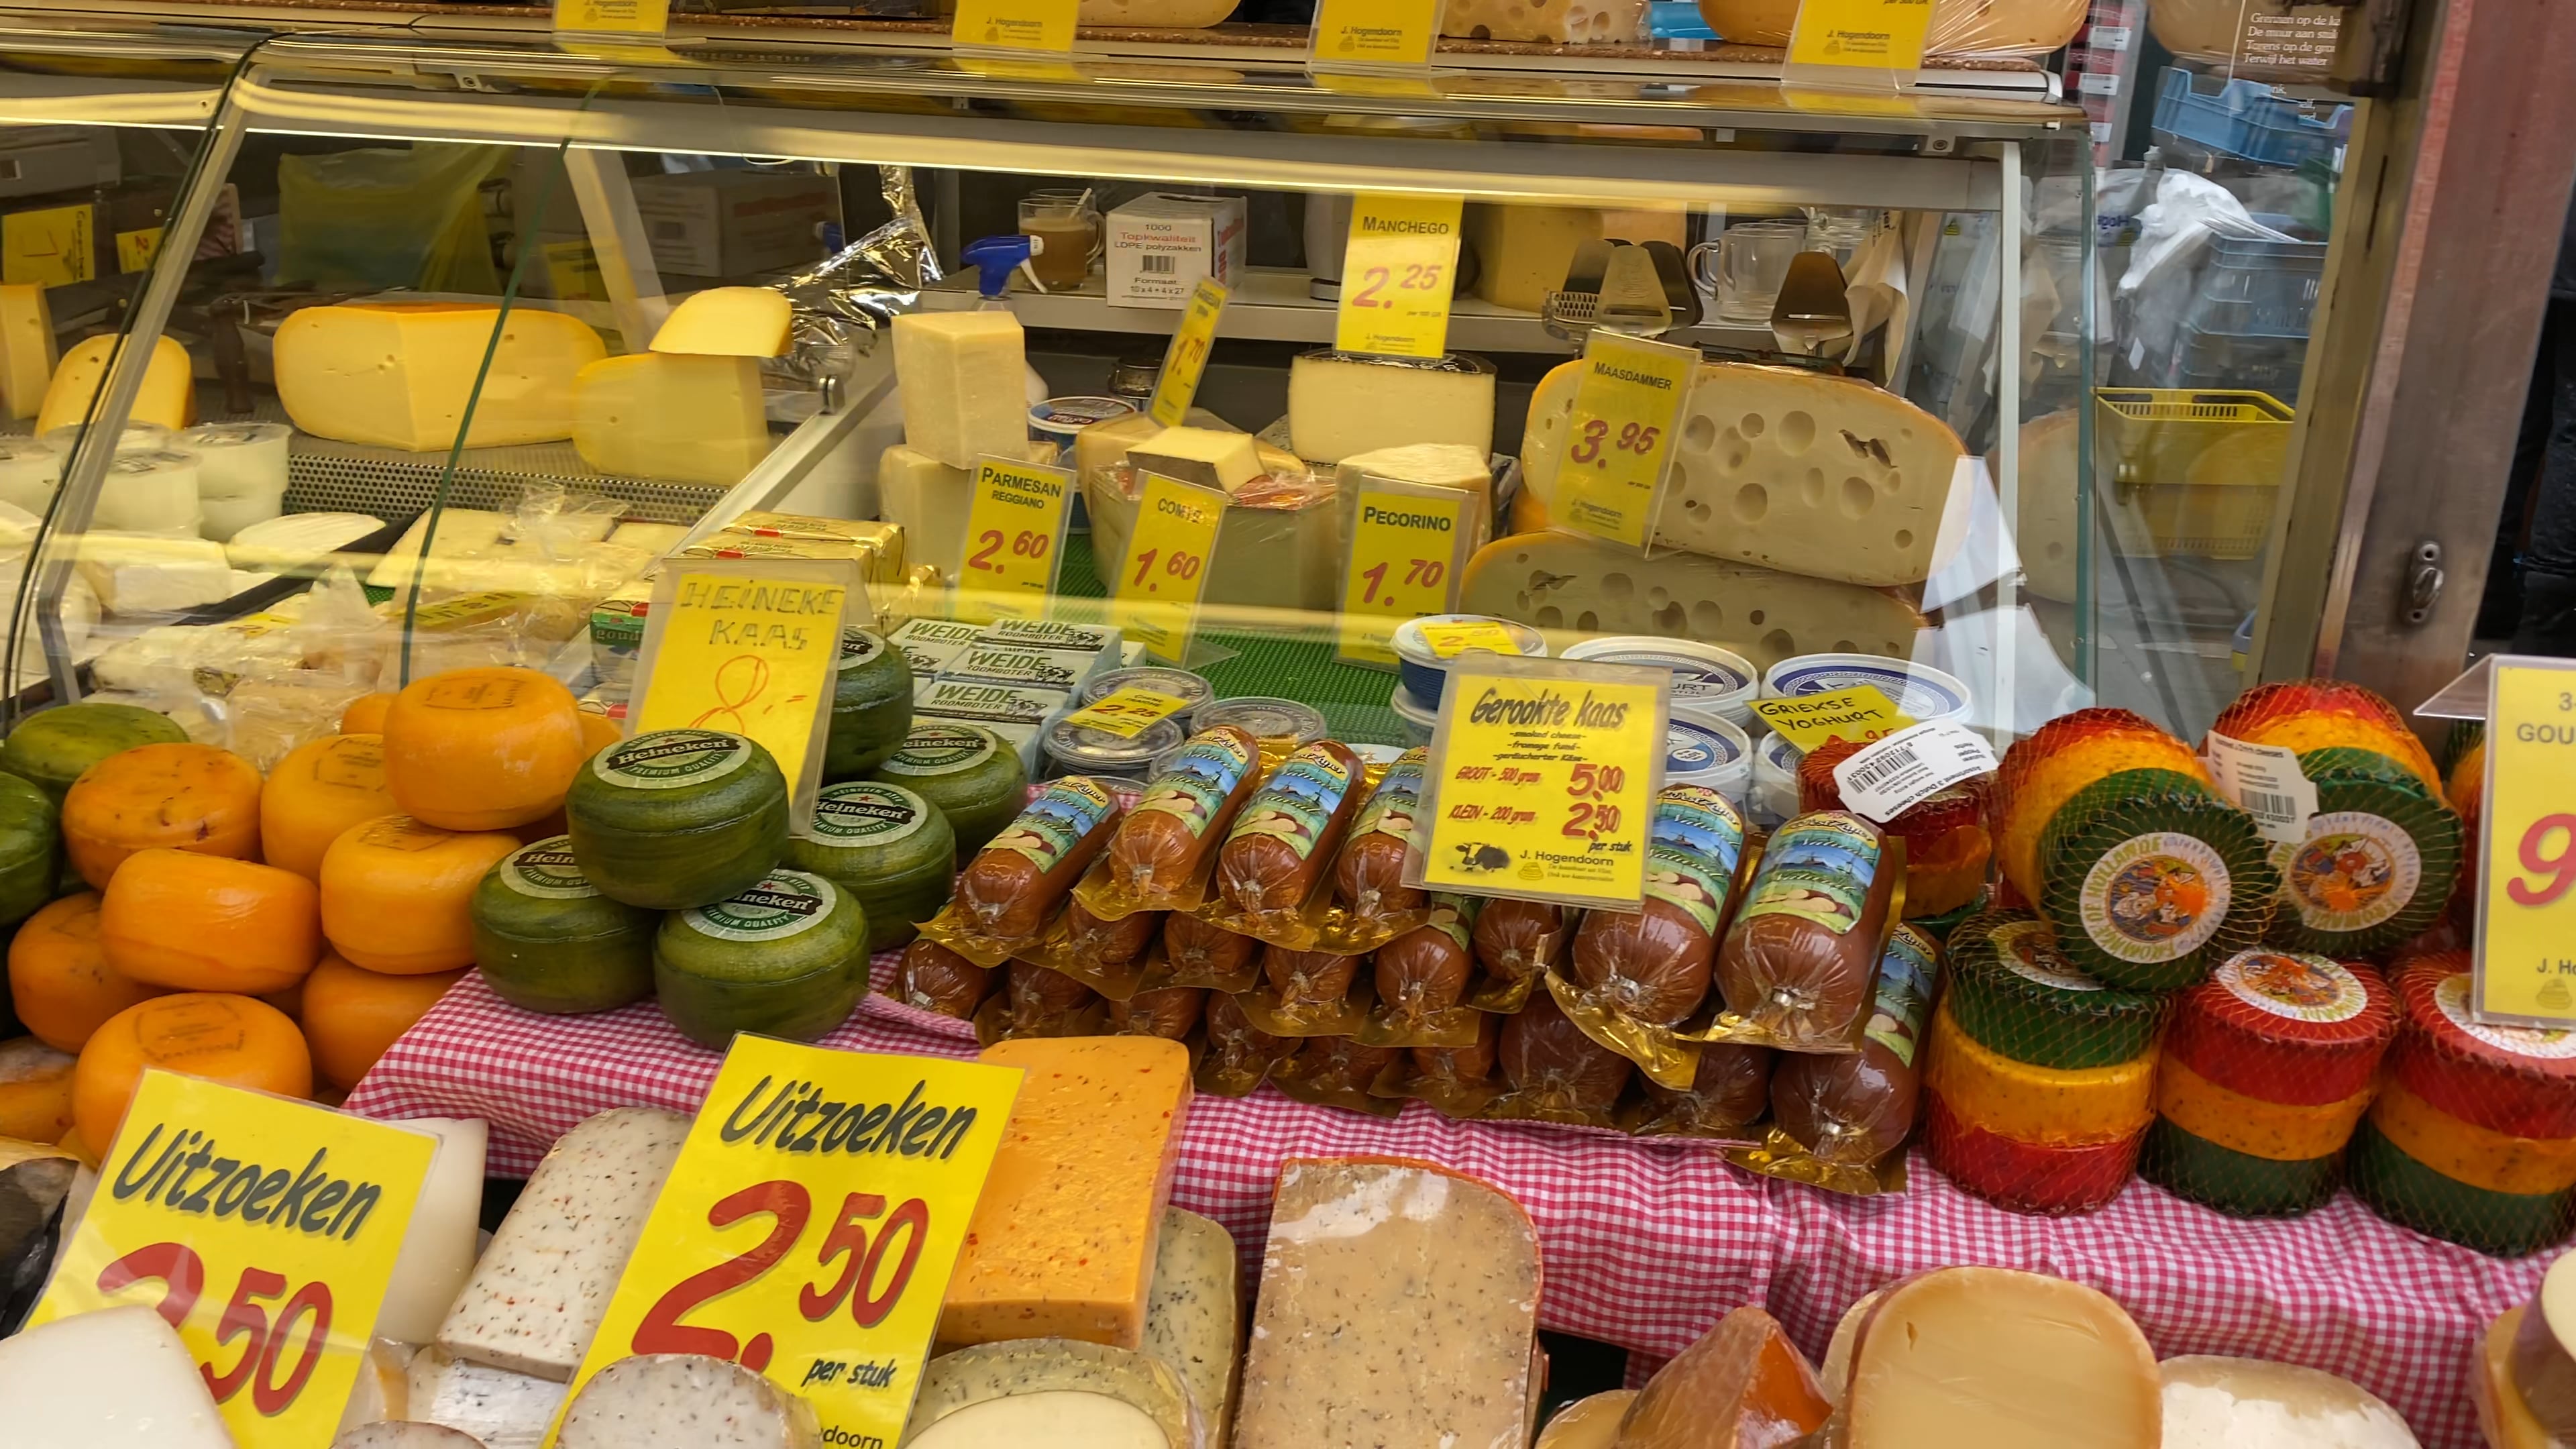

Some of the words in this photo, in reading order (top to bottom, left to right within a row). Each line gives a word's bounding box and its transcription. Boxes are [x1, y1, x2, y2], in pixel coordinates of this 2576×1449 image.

[2297, 17, 2311, 26] op
[2313, 15, 2326, 25] de
[1341, 26, 1348, 34] J.
[1350, 26, 1403, 36] Hogendoorn
[2247, 26, 2264, 36] De
[2295, 30, 2315, 38] aan
[2283, 44, 2298, 53] op
[2300, 42, 2313, 52] de
[2279, 54, 2296, 64] het
[2298, 58, 2328, 66] water
[1362, 215, 1450, 235] MANCHEGO
[1120, 231, 1197, 243] Topkwaliteit
[1146, 244, 1201, 252] polyzakken
[1134, 277, 1178, 285] Formaat
[1593, 362, 1672, 390] MAASDAMMER
[981, 466, 1062, 498] PARMESAN
[991, 490, 1045, 510] REGGIANO
[1362, 505, 1452, 532] PECORINO
[708, 619, 810, 651] KAAS
[909, 622, 985, 641] WEIDE
[1002, 620, 1081, 635] WEIDE
[904, 634, 967, 647] ROOMBOTER
[998, 631, 1063, 641] ROOMBOTER
[967, 650, 1052, 670] WEIDE
[966, 664, 1033, 678] ROOMBOTER
[934, 684, 1024, 704] WEIDE
[930, 699, 1004, 710] ROOMBOTER
[1470, 687, 1570, 726] Gerookte
[1573, 689, 1629, 729] kaas
[1776, 708, 1884, 731] YOGHURT
[903, 738, 978, 747] eineken
[617, 739, 729, 765] Heineken
[934, 751, 969, 764] QUALITY
[629, 766, 681, 776] PREMIUM
[685, 753, 724, 772] QUALITY
[1455, 765, 1493, 780] GROOT
[1498, 767, 1520, 782] 500
[1913, 783, 1939, 798] Dutch
[816, 801, 904, 819] Heineken
[1448, 804, 1485, 820] KLEIN
[1490, 806, 1513, 820] 200
[1884, 795, 1915, 816] cheeses
[846, 822, 888, 835] QUALITY
[1587, 841, 1607, 854] per
[1609, 841, 1633, 853] stuk
[524, 853, 576, 864] Hein
[1519, 849, 1532, 859] J.
[1536, 851, 1615, 867] Hogendoorn
[735, 894, 813, 911] neken
[744, 914, 790, 928] QUALITY
[2536, 958, 2552, 974] J.
[718, 1074, 979, 1162] Uitzoeken
[111, 1122, 382, 1242] Uitzoeken
[800, 1358, 847, 1388] per
[846, 1358, 898, 1389] stuk
